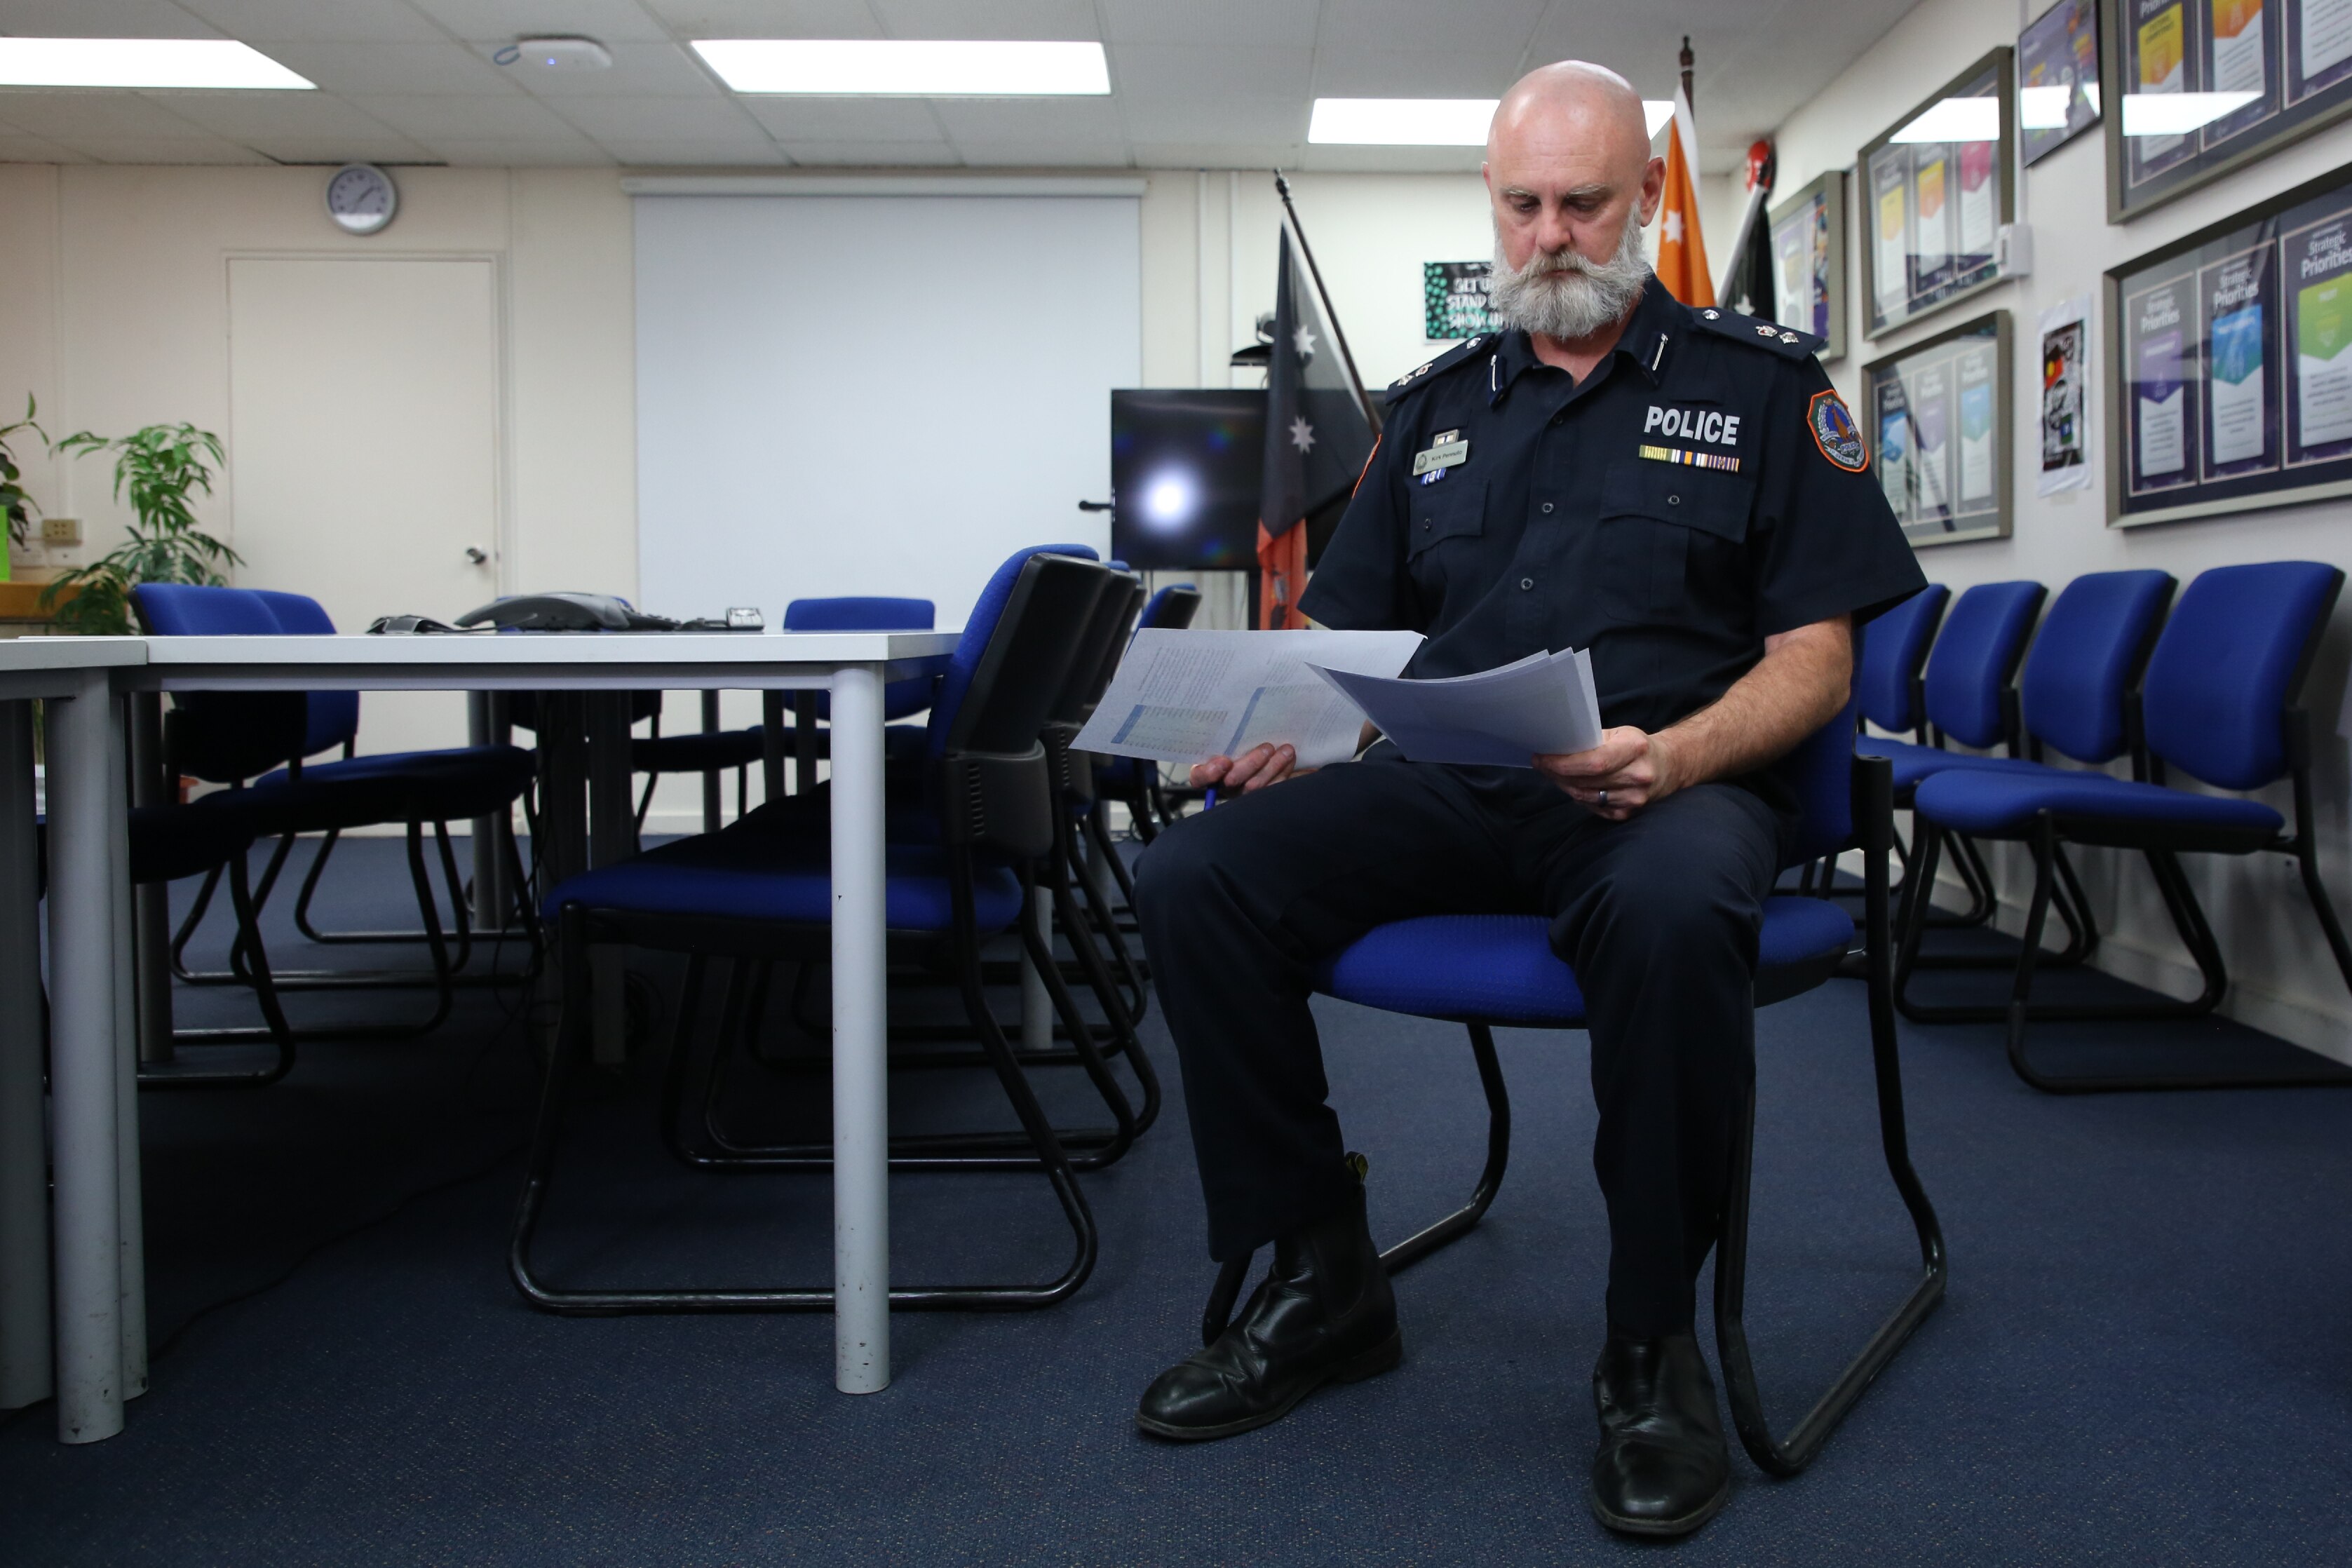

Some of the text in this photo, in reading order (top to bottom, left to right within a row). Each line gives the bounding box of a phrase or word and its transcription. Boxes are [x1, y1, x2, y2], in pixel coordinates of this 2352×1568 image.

[2309, 230, 2346, 256] Strategic
[1446, 295, 1487, 311] STAND
[2214, 282, 2259, 311] Priorities
[1644, 405, 1740, 445] POLICE
